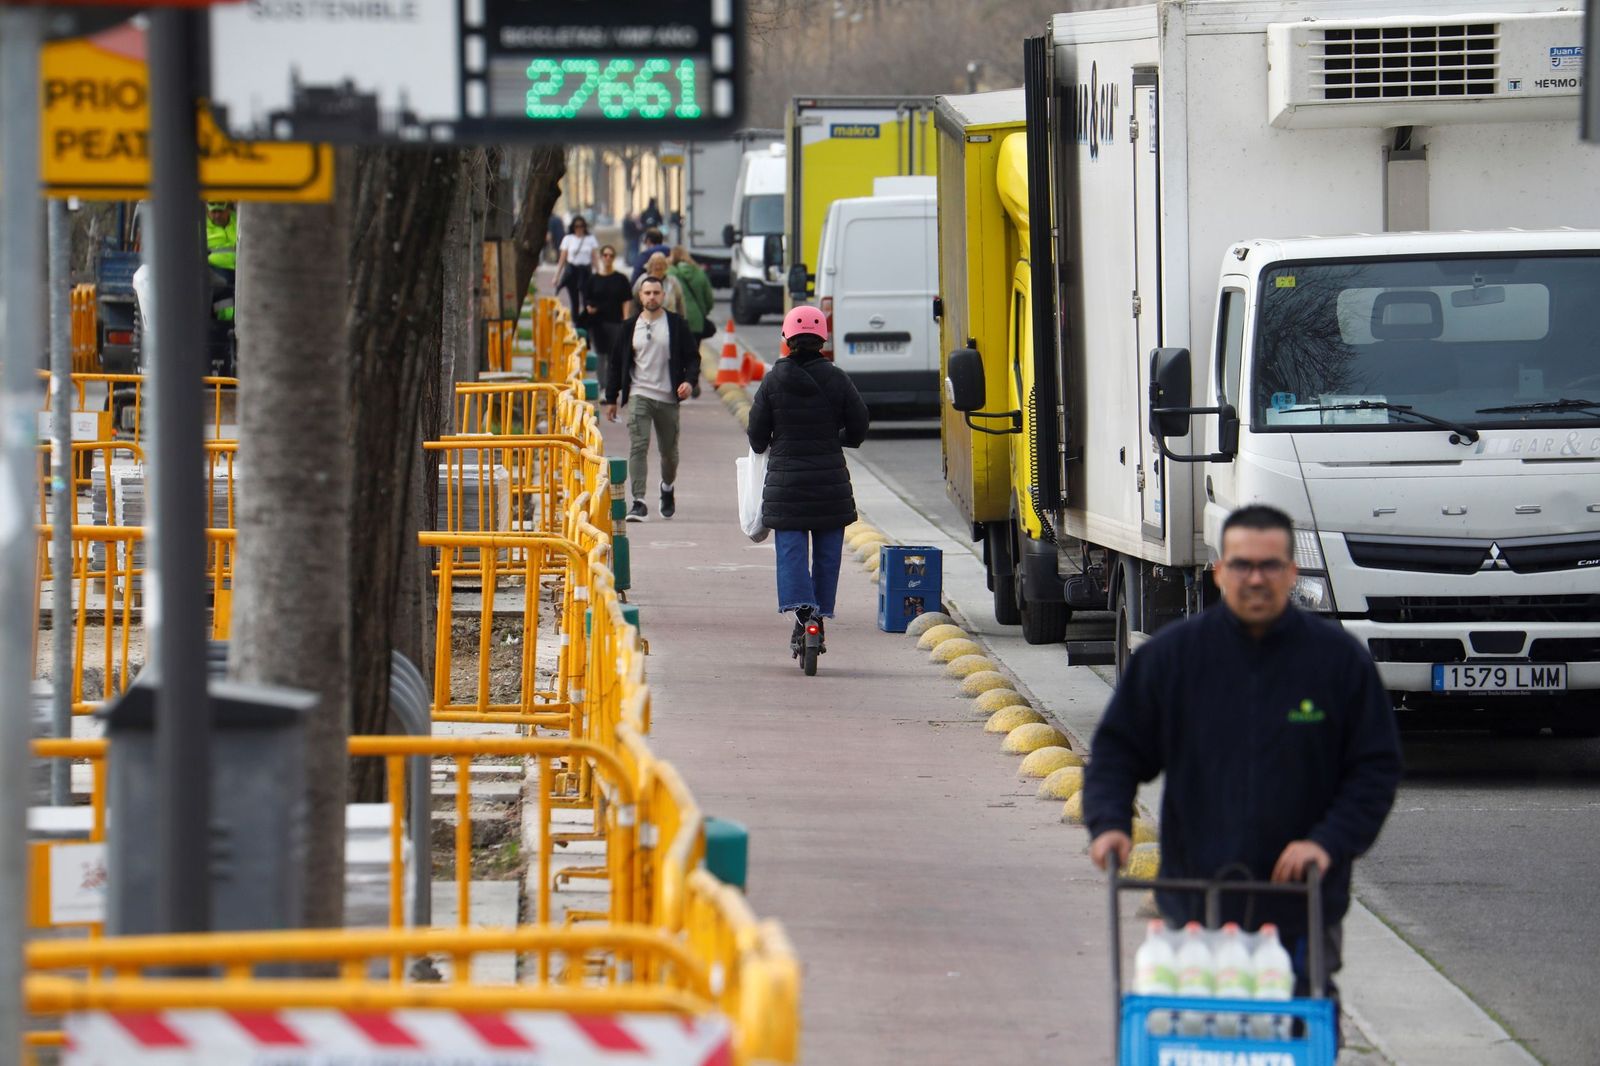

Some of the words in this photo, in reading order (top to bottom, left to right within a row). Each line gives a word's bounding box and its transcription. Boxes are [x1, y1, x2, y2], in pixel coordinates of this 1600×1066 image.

[526, 59, 700, 118] 27661
[833, 125, 876, 137] makro
[1451, 667, 1507, 687] 1579
[1516, 667, 1560, 687] LMM
